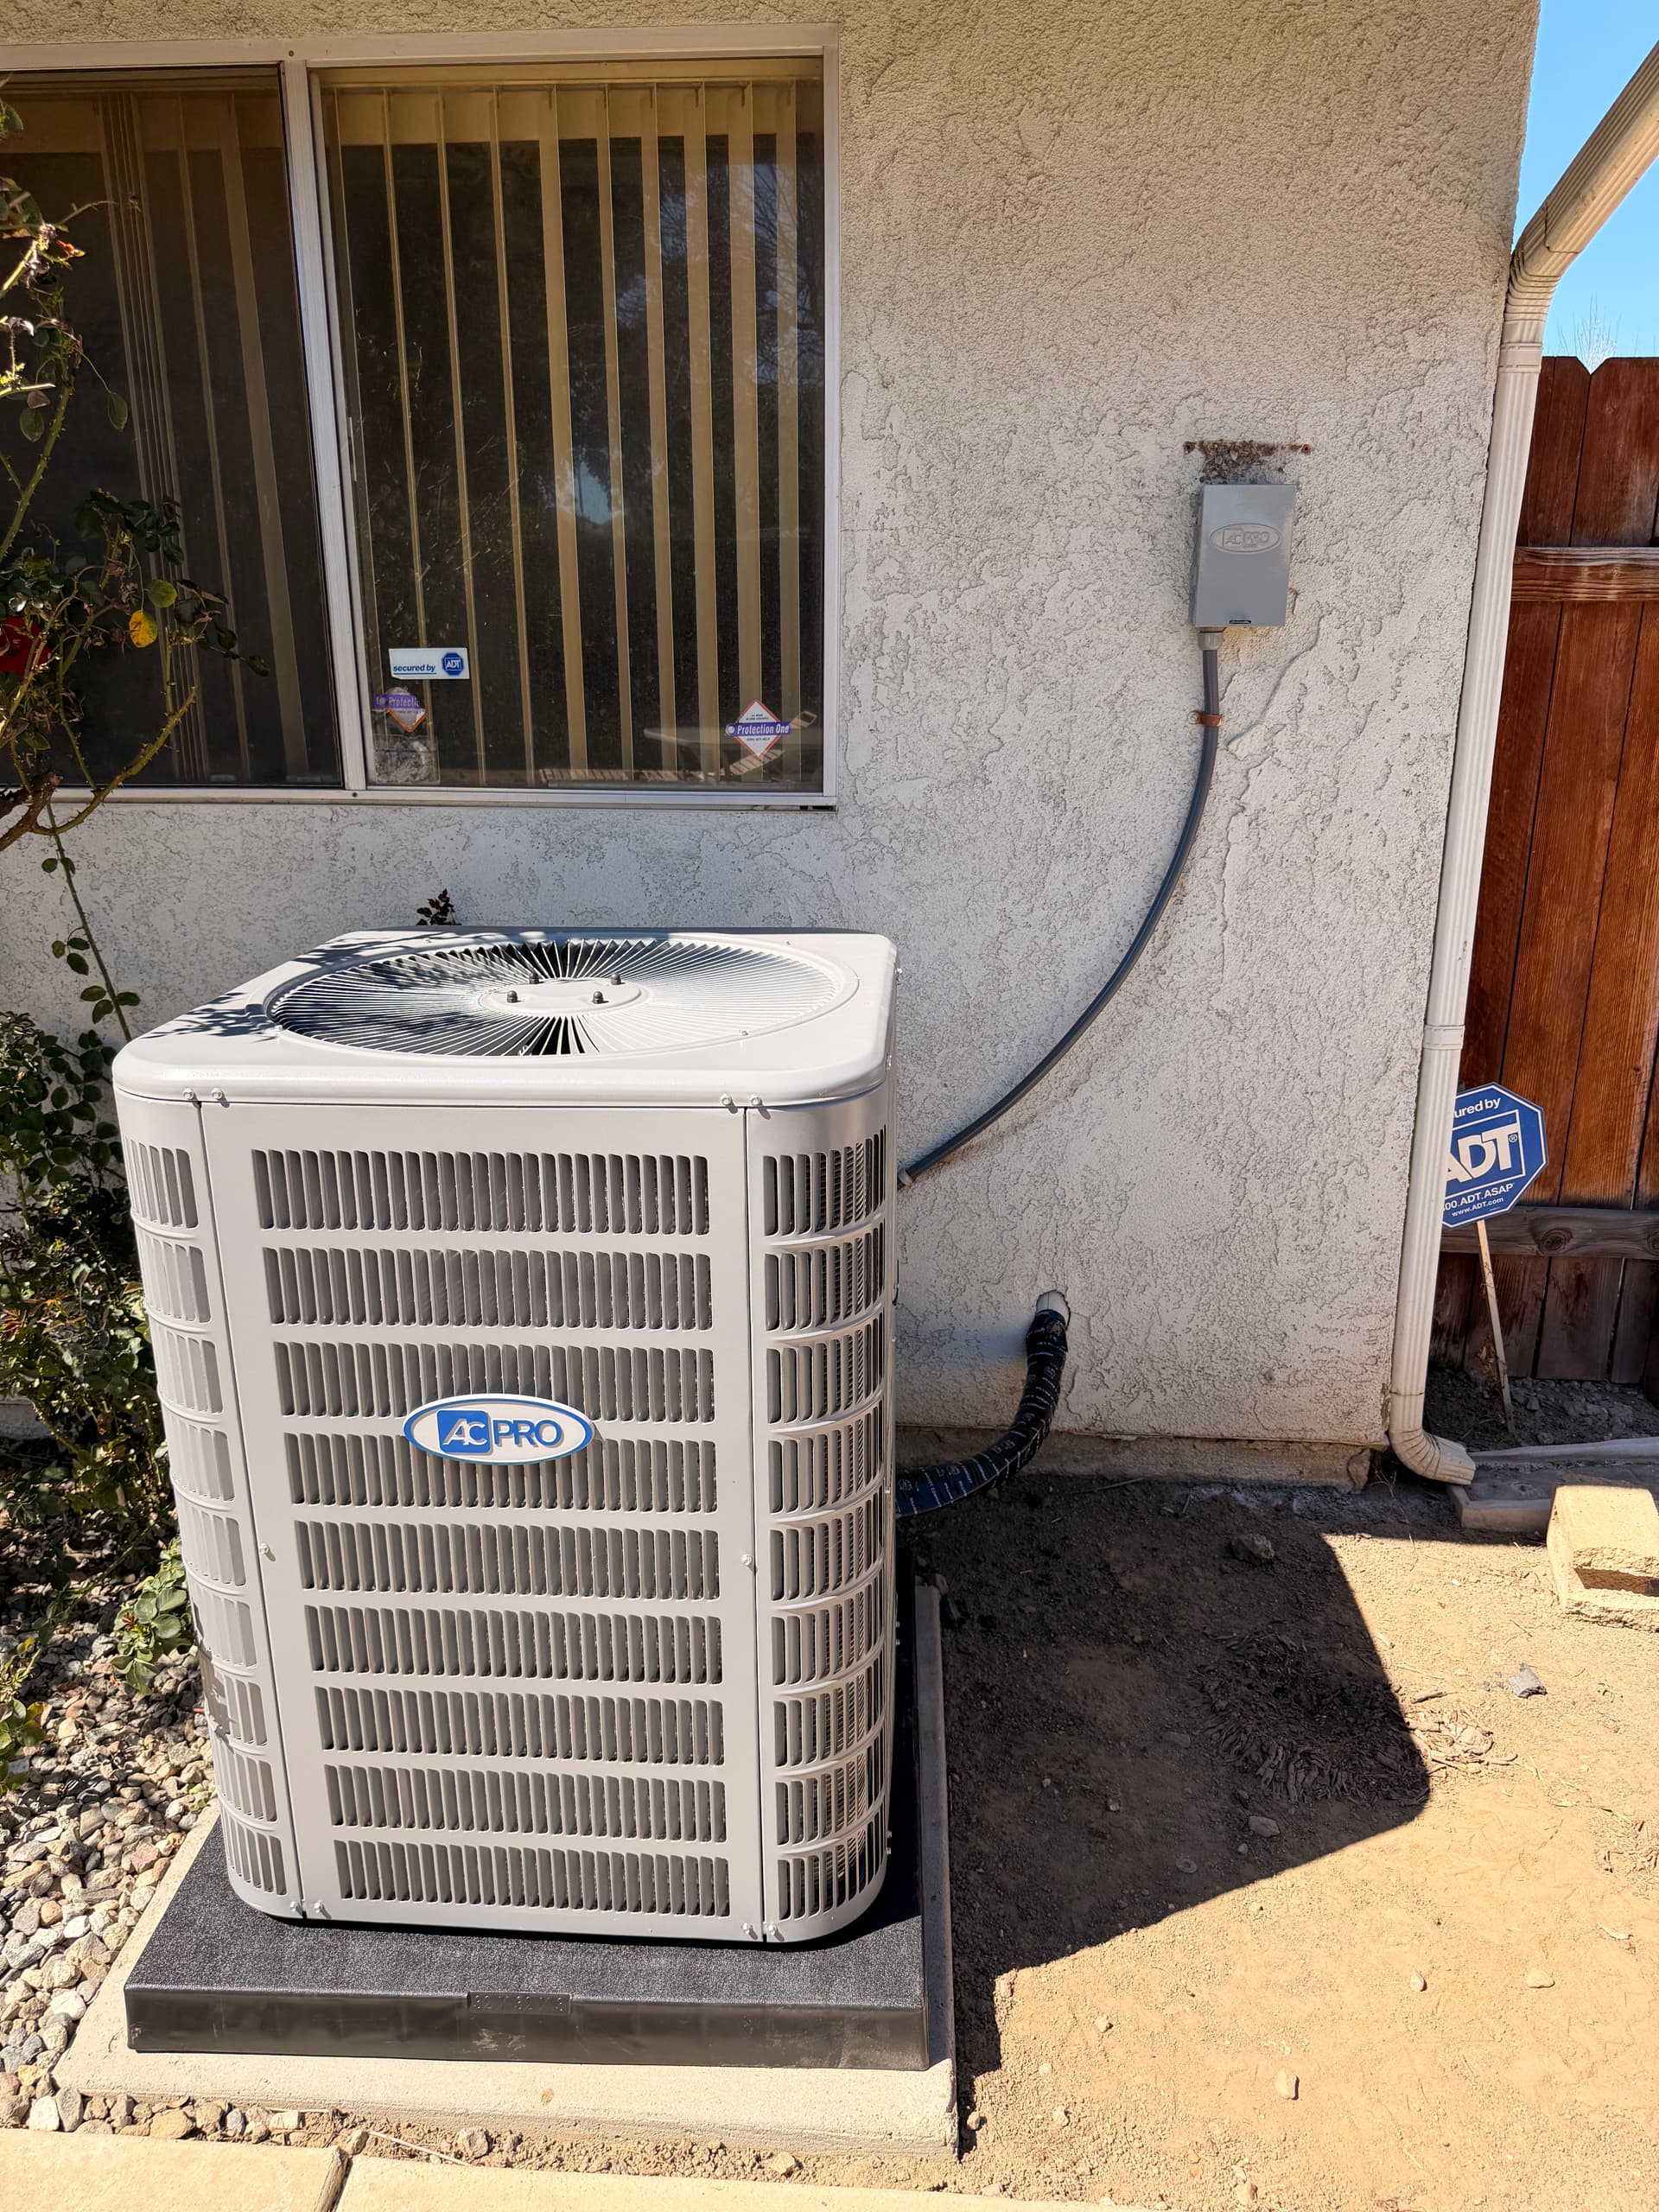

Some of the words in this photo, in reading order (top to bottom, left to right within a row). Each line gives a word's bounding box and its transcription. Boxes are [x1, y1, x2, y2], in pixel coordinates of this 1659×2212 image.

[426, 664, 436, 672] by
[446, 659, 461, 669] ADT
[737, 725, 773, 734] Protection
[776, 724, 789, 734] One
[1453, 1101, 1484, 1118] ured
[1484, 1097, 1501, 1109] by
[1443, 1182, 1514, 1211] 00.ADT.ASAP
[1452, 1197, 1504, 1217] www.ADT.com
